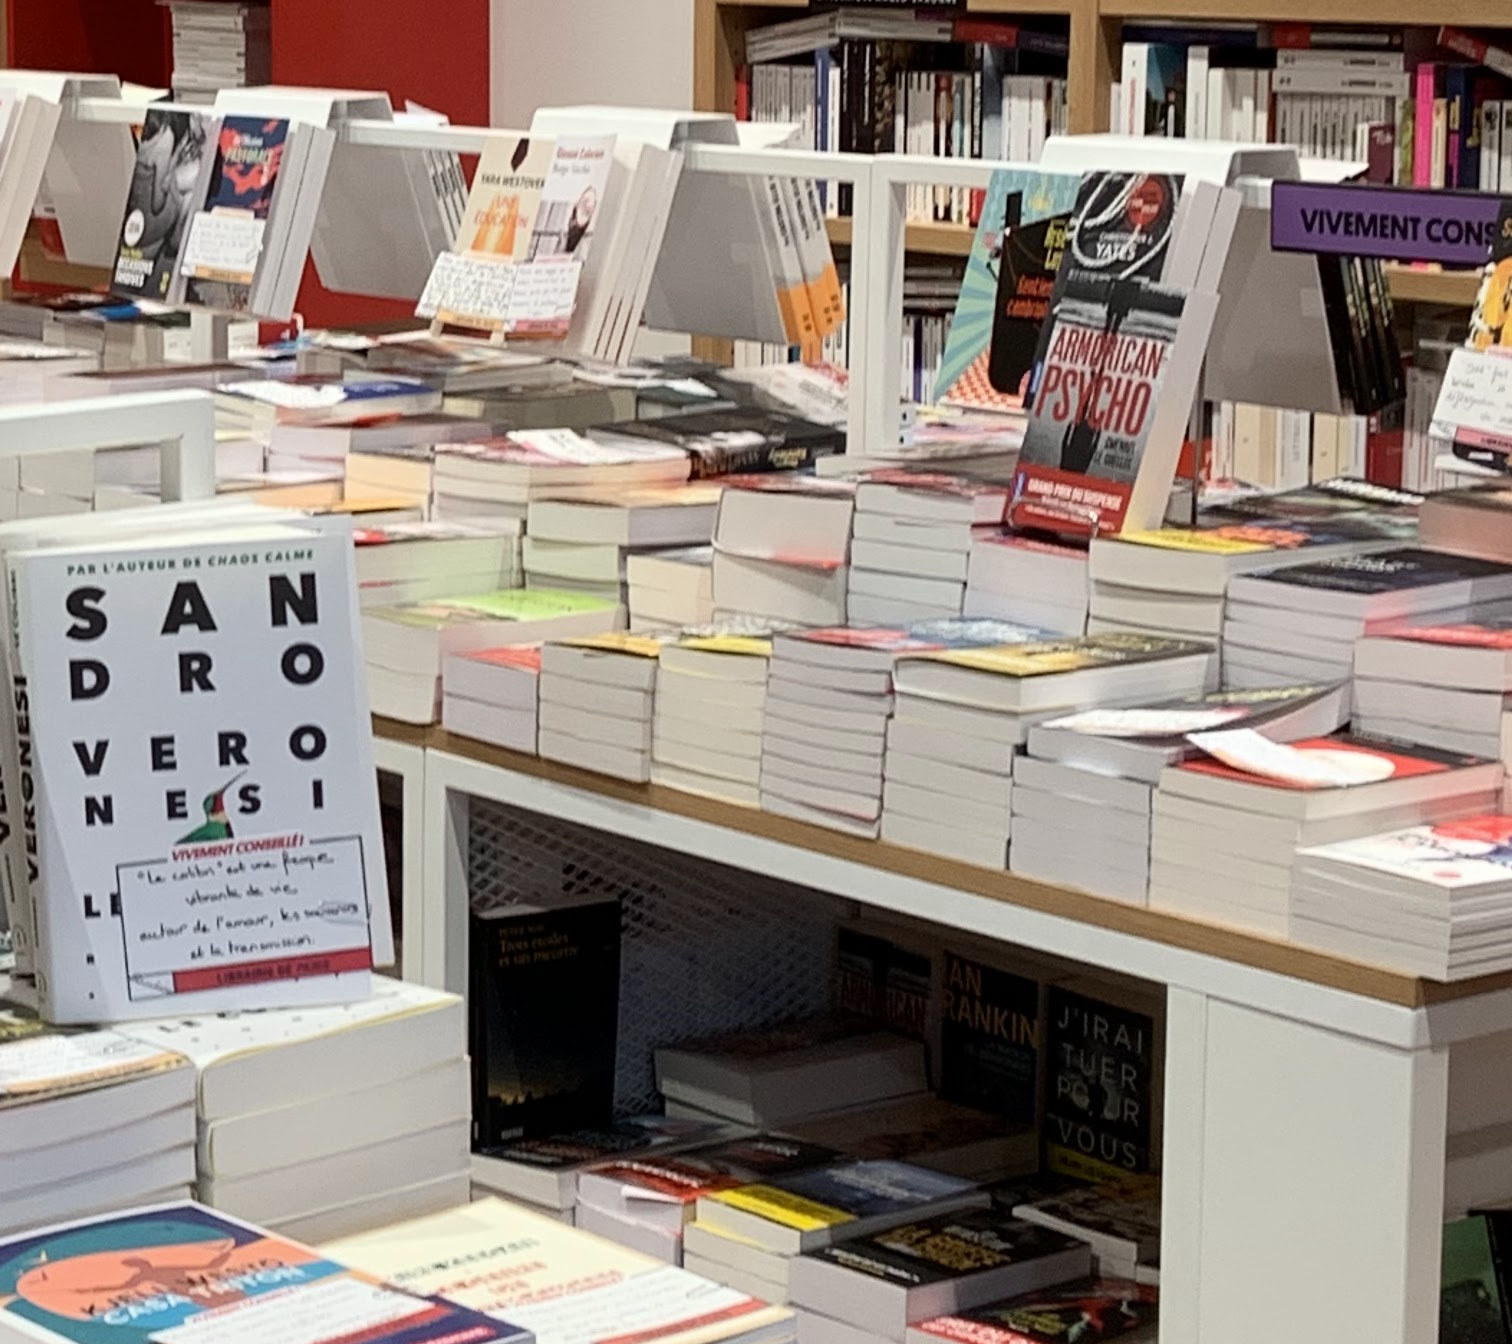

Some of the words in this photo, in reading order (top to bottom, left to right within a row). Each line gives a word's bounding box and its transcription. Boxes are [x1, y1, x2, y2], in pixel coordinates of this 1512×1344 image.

[1301, 208, 1421, 241] VIVEMENT
[1050, 326, 1165, 380] ARMORICAN
[1034, 364, 1152, 437] PSYCHO
[67, 562, 96, 576] PAR
[103, 558, 175, 575] L'AUTEUR
[183, 557, 201, 568] DE
[208, 552, 259, 567] CHAOS
[265, 548, 315, 563] CALME
[13, 674, 40, 884] VERONESI
[172, 841, 233, 862] VIVEMENT
[1057, 1004, 1144, 1055] J'IRAI
[1060, 1043, 1138, 1093] TUER
[1056, 1076, 1140, 1128] POUR
[1048, 1112, 1138, 1170] VOUS
